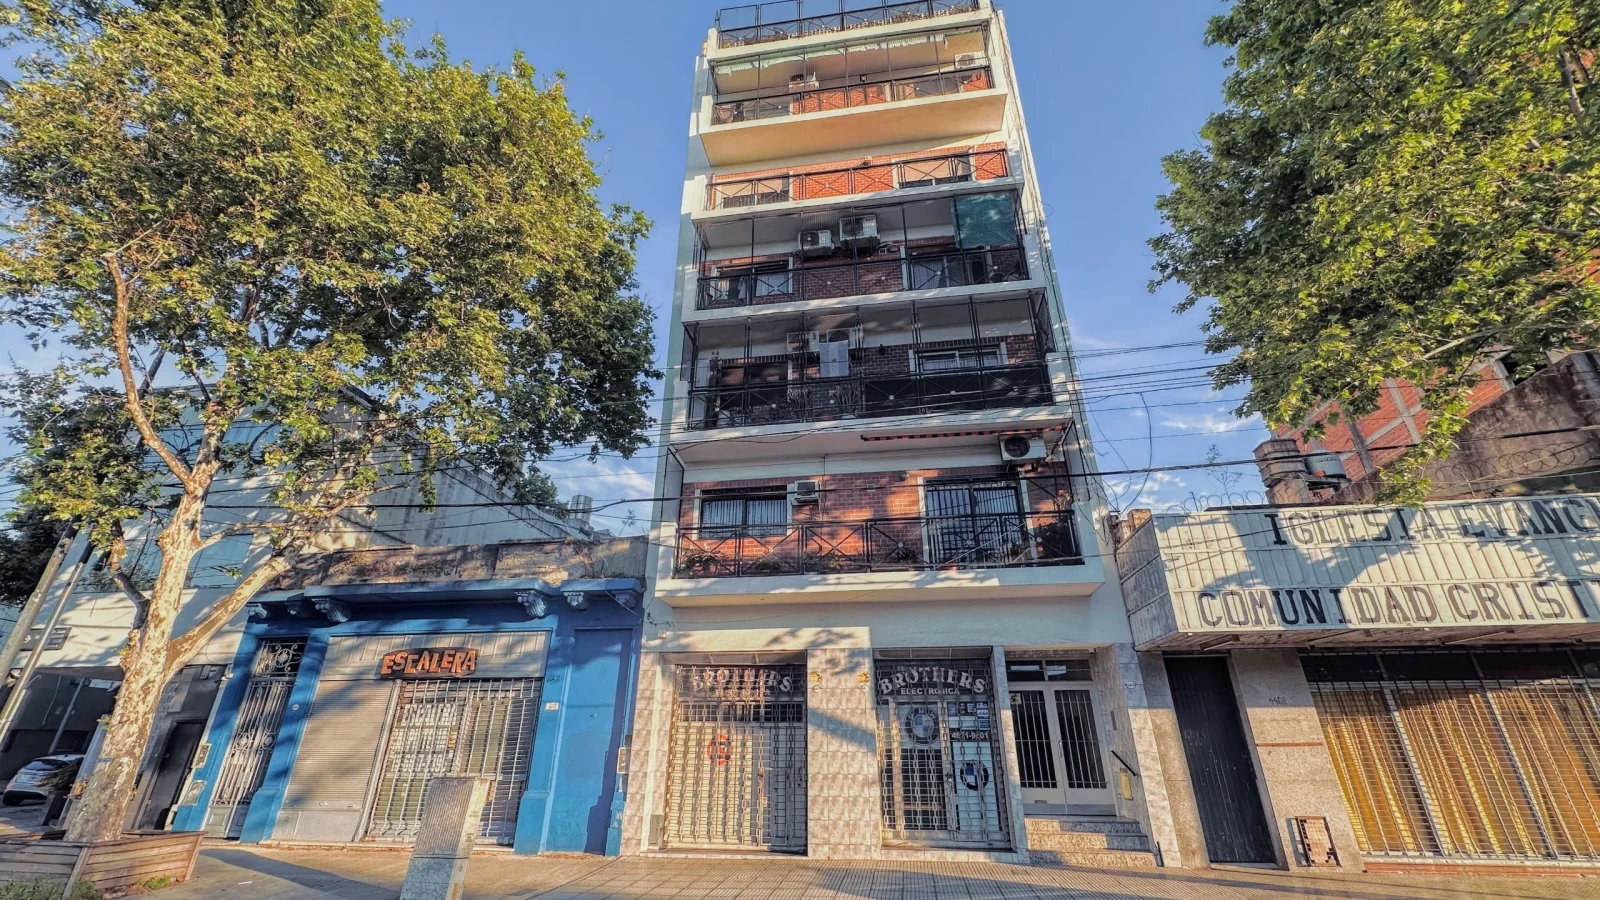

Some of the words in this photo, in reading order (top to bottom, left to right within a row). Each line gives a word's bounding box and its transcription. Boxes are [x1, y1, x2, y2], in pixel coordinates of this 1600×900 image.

[1264, 506, 1439, 546] IGLESIA
[1453, 497, 1600, 538] EVANG
[1199, 584, 1437, 626] COMUNIDAD
[1447, 579, 1600, 622] CRIST
[380, 649, 476, 675] ESCALERA
[878, 666, 986, 695] BROTHERS
